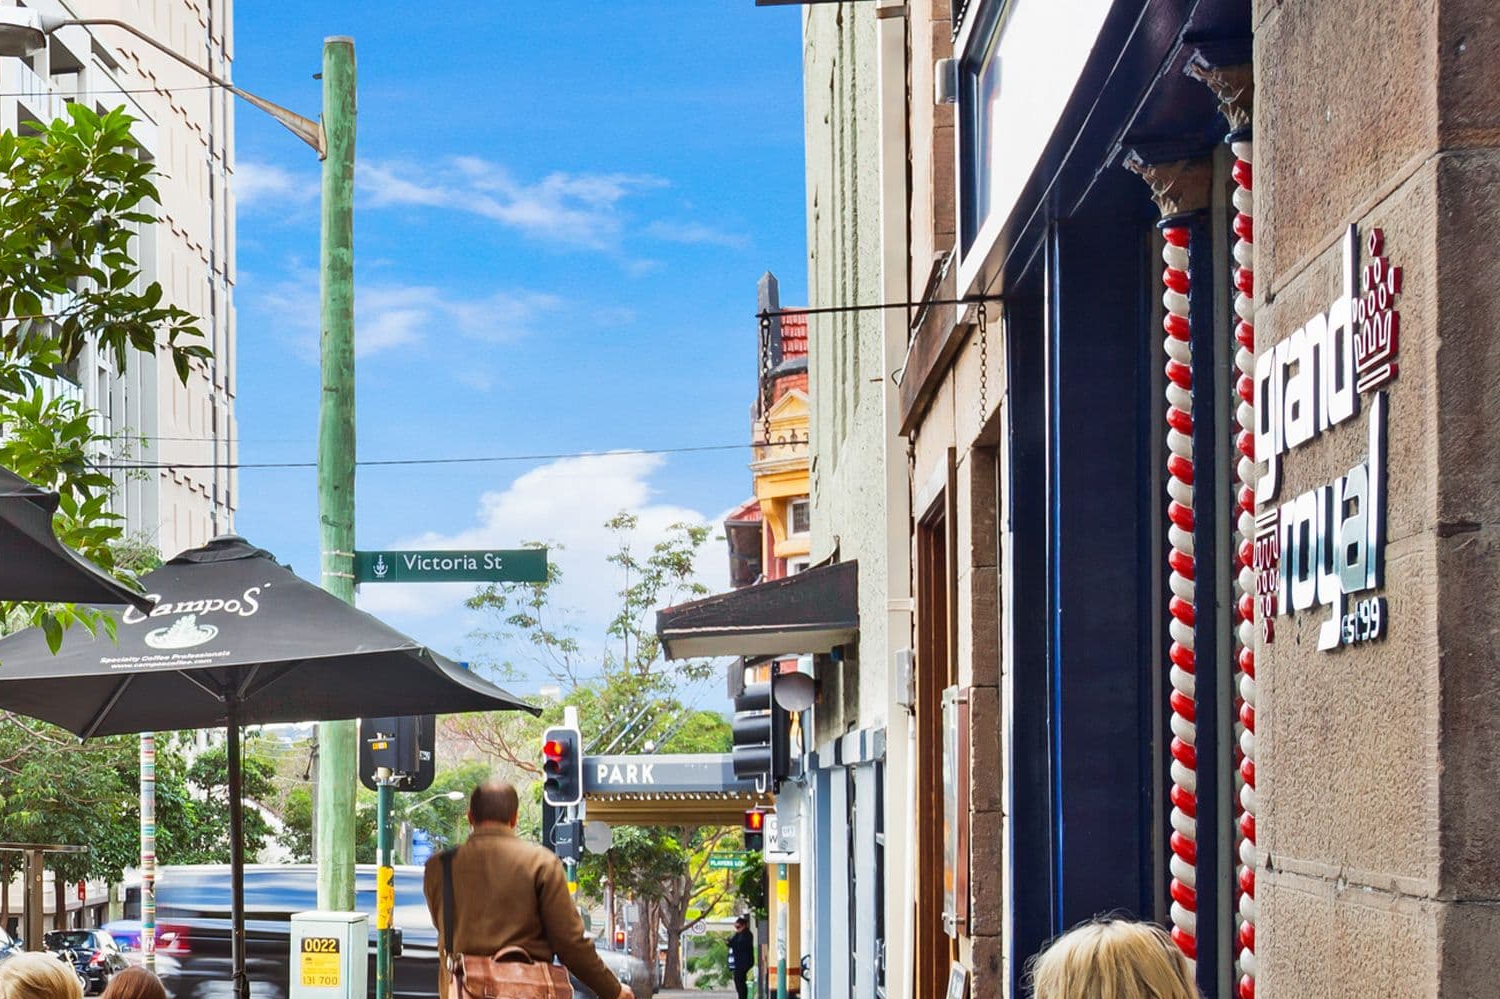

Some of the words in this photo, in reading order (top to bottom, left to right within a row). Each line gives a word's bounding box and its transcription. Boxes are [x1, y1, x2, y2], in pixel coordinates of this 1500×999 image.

[1254, 223, 1359, 505] grand
[1278, 391, 1388, 652] royal
[403, 553, 478, 571] Victoria
[483, 553, 503, 570] St
[100, 655, 141, 664] Specialty
[141, 654, 170, 662] Coffee
[597, 763, 655, 785] PARK
[304, 938, 337, 952] 0022
[303, 976, 315, 985] 131
[319, 976, 338, 985] 700
